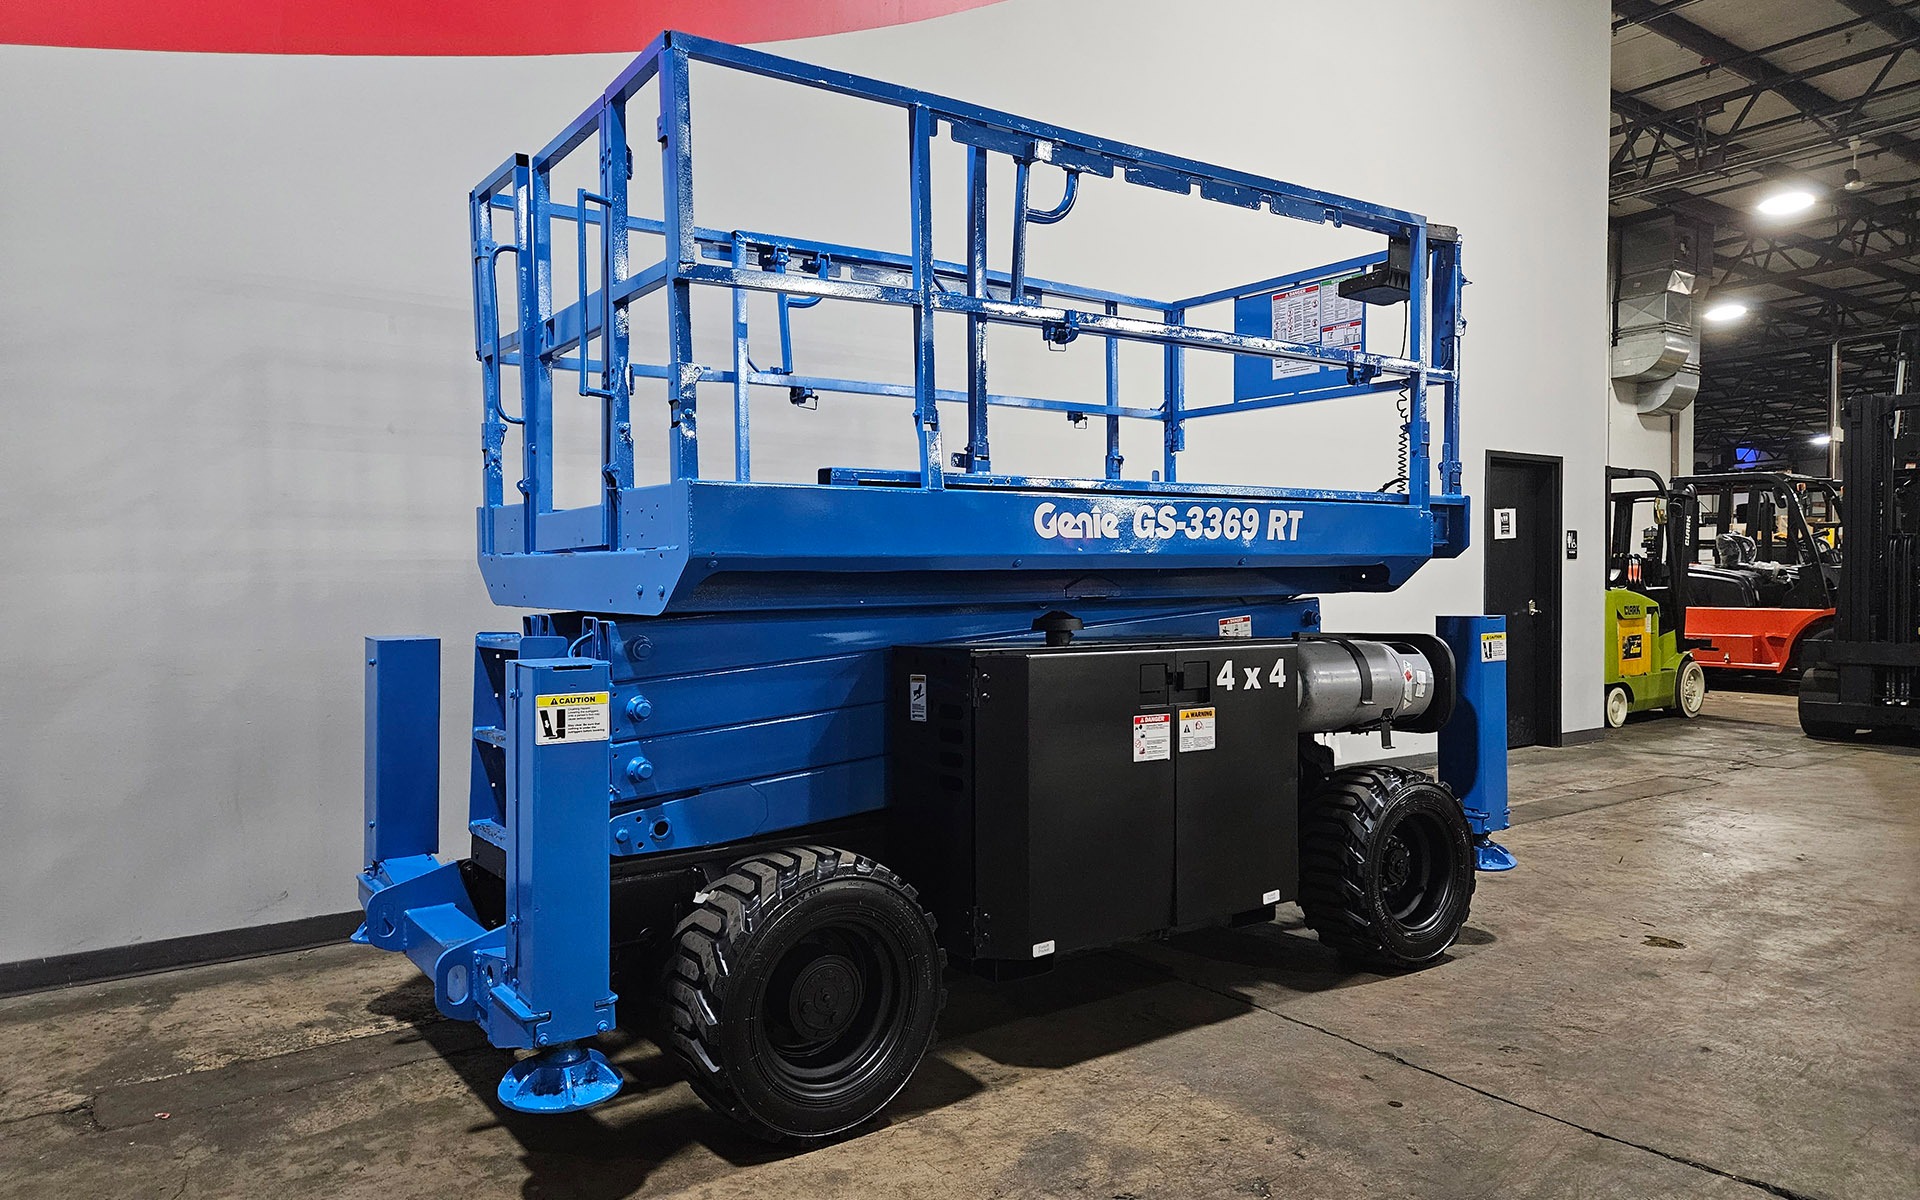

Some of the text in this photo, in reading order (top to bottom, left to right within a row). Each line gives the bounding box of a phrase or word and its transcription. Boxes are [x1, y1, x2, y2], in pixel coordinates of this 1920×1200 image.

[1034, 502, 1304, 541] Genie GS-3369 RT
[1684, 515, 1692, 547] CLARK
[1216, 658, 1287, 691] 4 x 4
